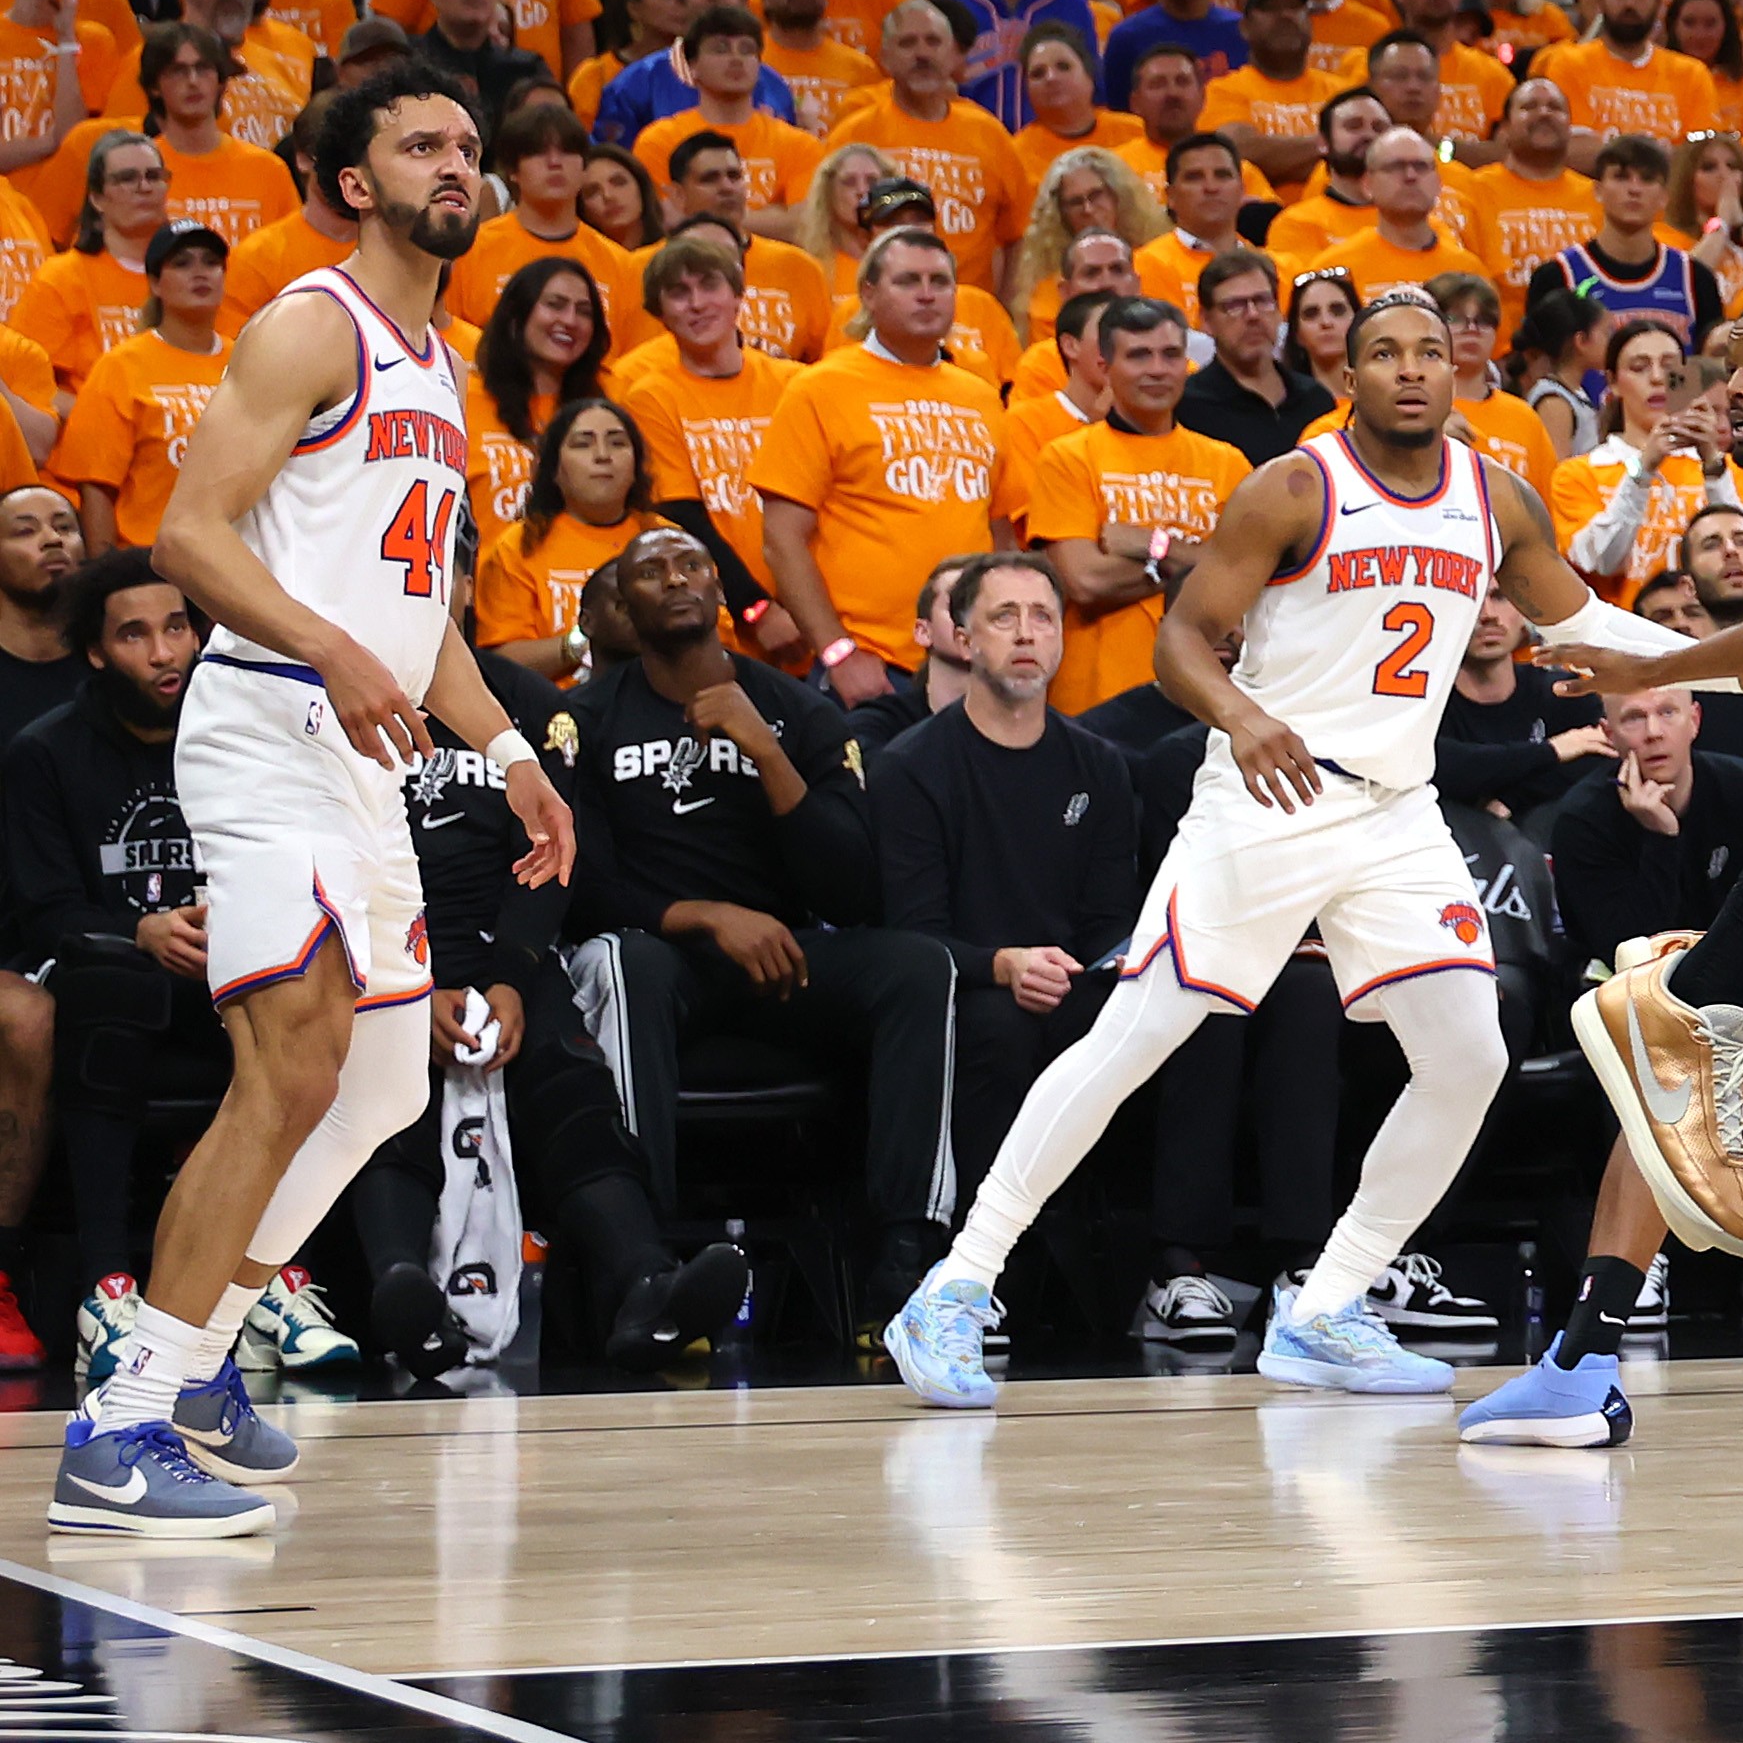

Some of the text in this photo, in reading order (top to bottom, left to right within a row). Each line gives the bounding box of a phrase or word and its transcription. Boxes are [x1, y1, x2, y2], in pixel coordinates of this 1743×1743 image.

[870, 411, 998, 468] FINALS
[1099, 484, 1220, 540] FINALS
[1372, 600, 1435, 699] 2
